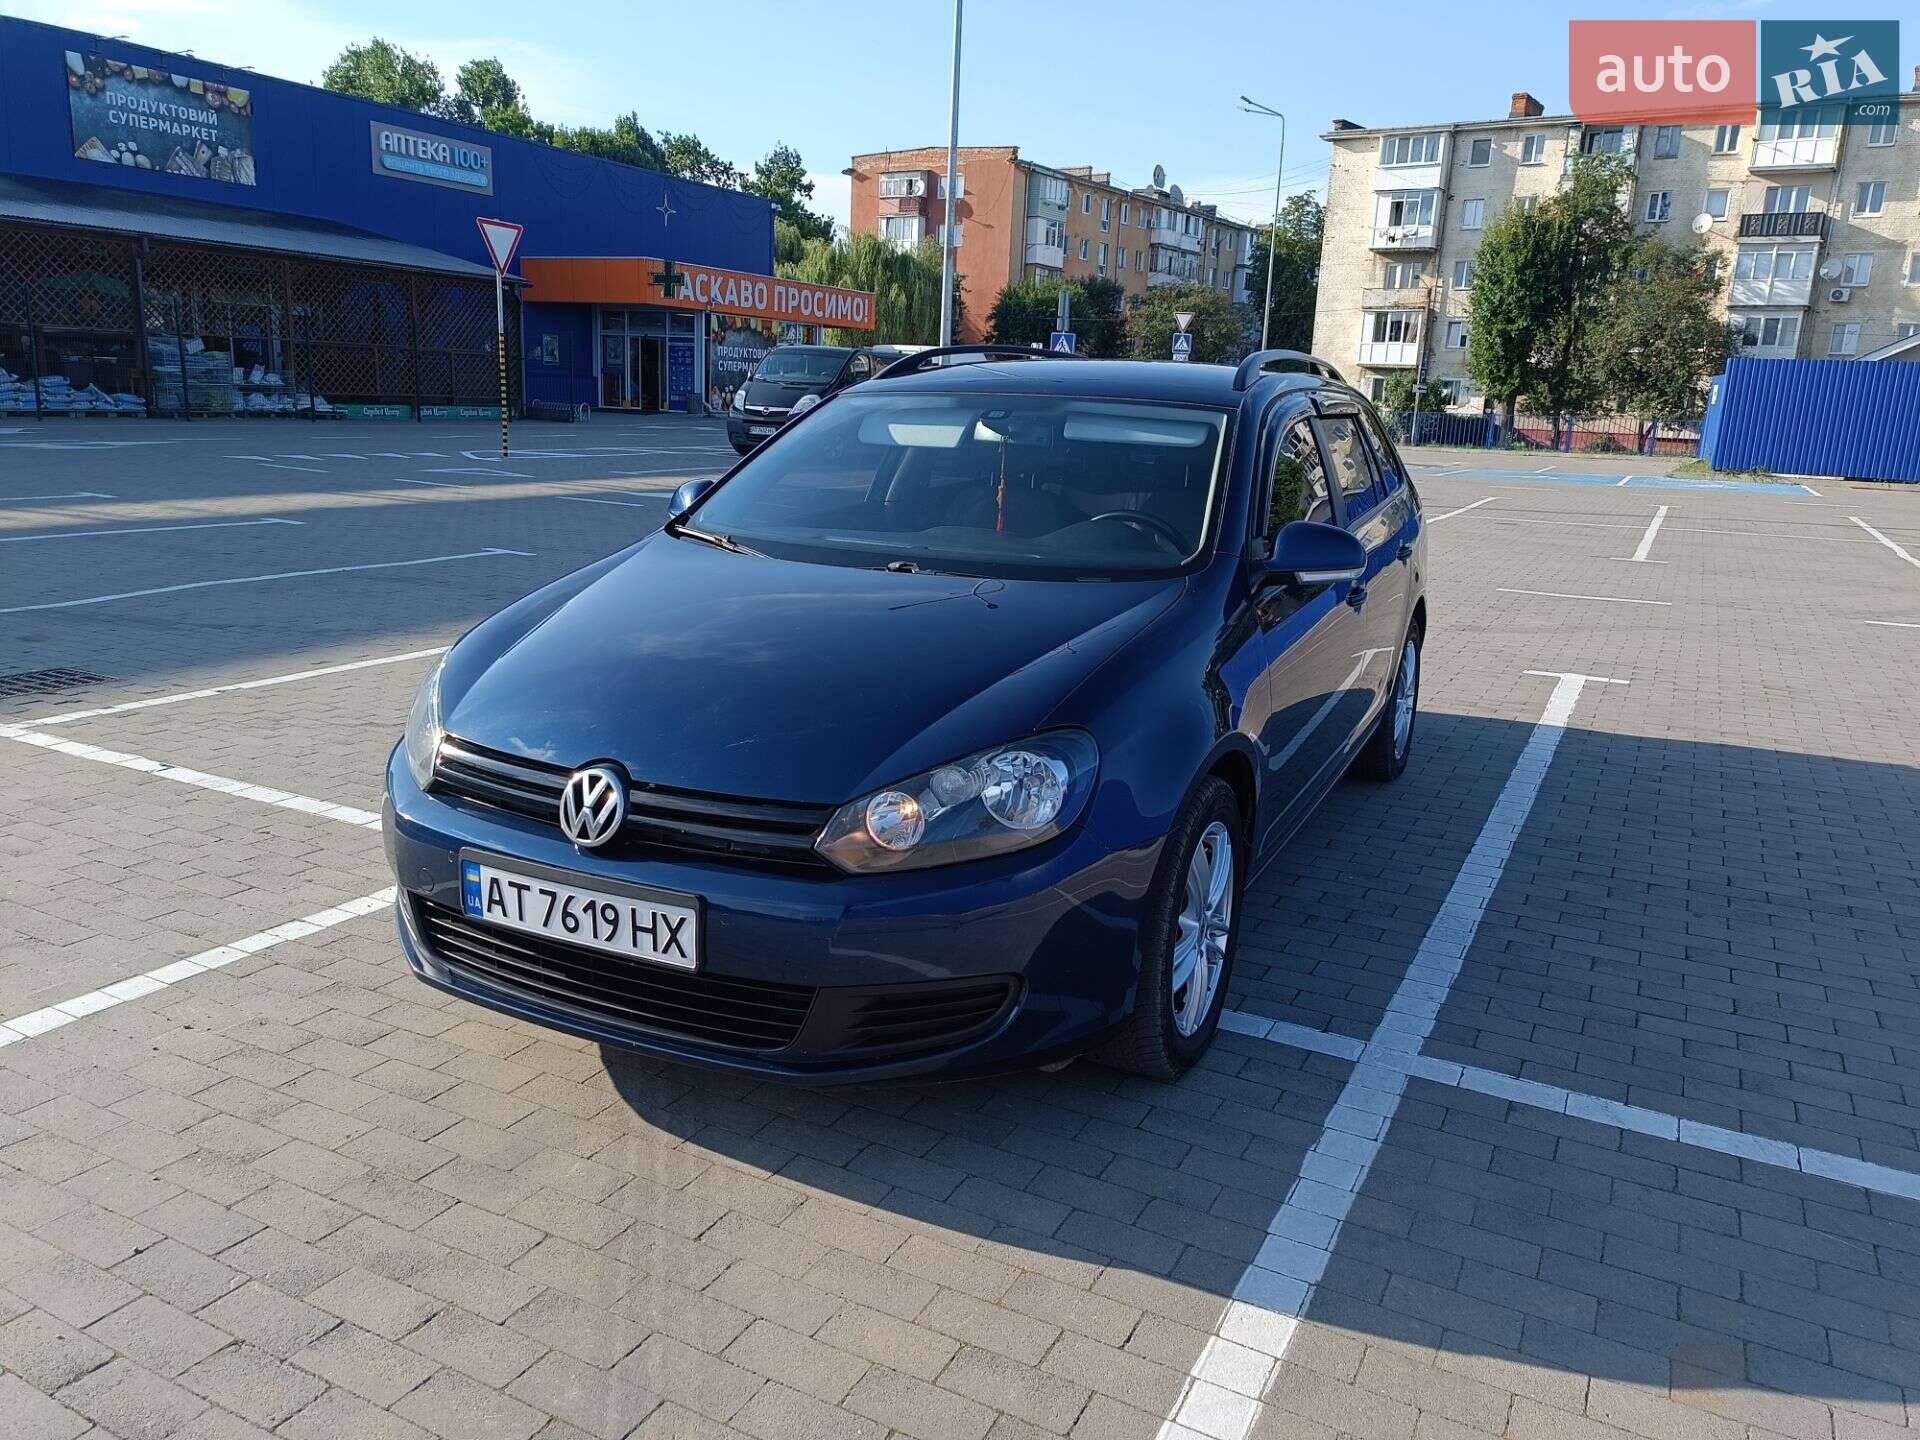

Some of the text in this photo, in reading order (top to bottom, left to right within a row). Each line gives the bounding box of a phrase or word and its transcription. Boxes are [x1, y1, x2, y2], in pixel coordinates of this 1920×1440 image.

[105, 91, 218, 126] ПРОДУКТОВИЙ
[108, 110, 218, 143] СУПЕРМАРКЕТ
[379, 130, 489, 170] АПТЕКА 100+
[661, 271, 870, 323] АСКАВО ПРОСИМО!
[467, 893, 482, 910] UA
[486, 877, 688, 959] AT 7619 HX
